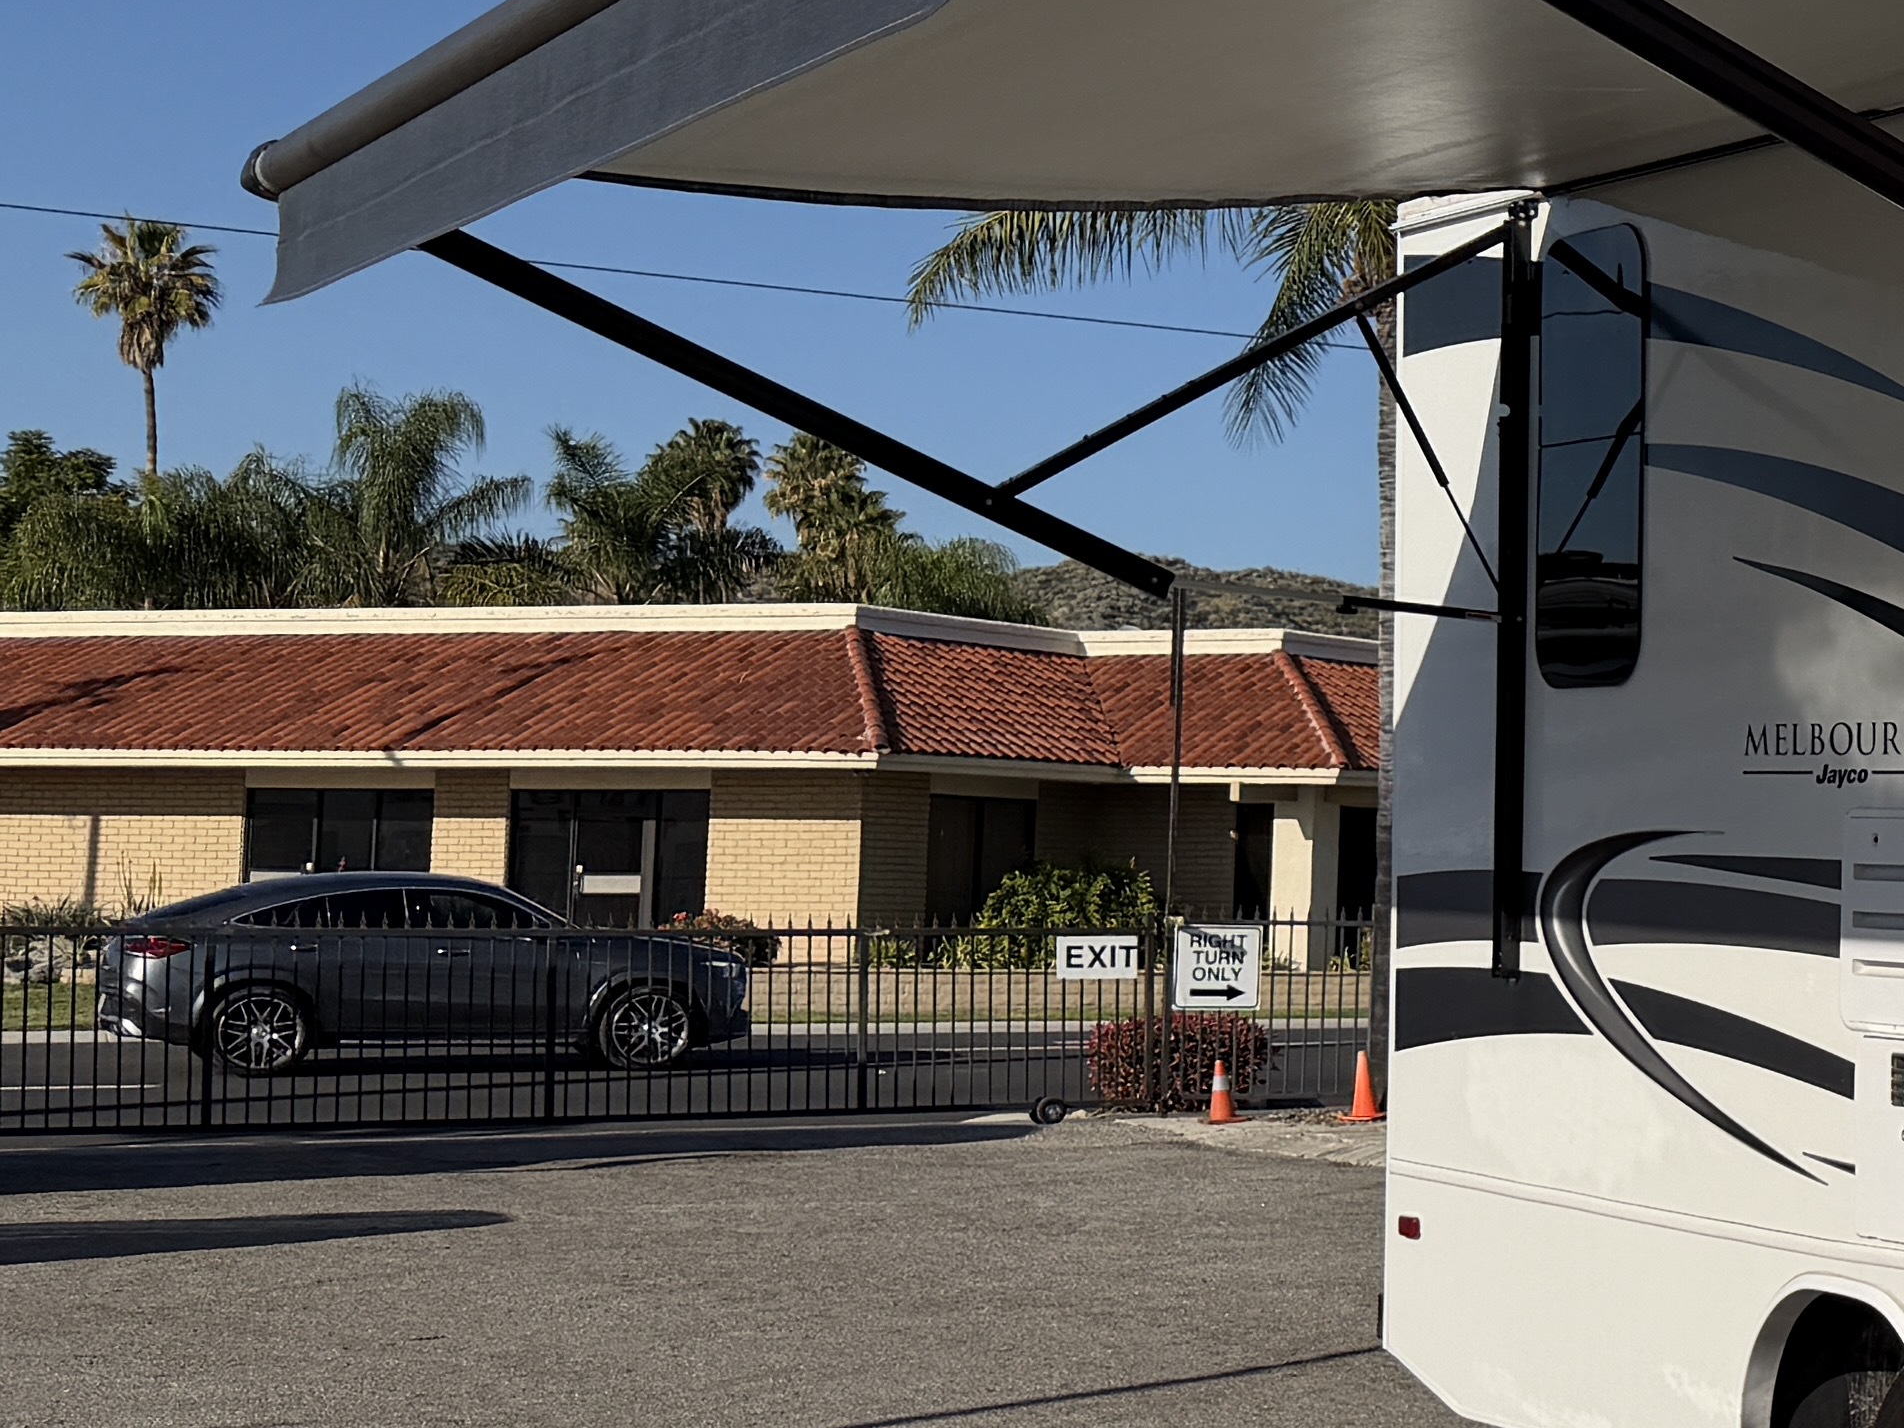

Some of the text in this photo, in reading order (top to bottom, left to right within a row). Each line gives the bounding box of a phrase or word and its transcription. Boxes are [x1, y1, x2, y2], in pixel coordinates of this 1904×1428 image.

[1816, 764, 1869, 788] Jayco
[1190, 934, 1247, 948] RIGHT
[1066, 945, 1137, 968] EXIT
[1193, 950, 1244, 965] TURN
[1192, 967, 1242, 981] ONLY
